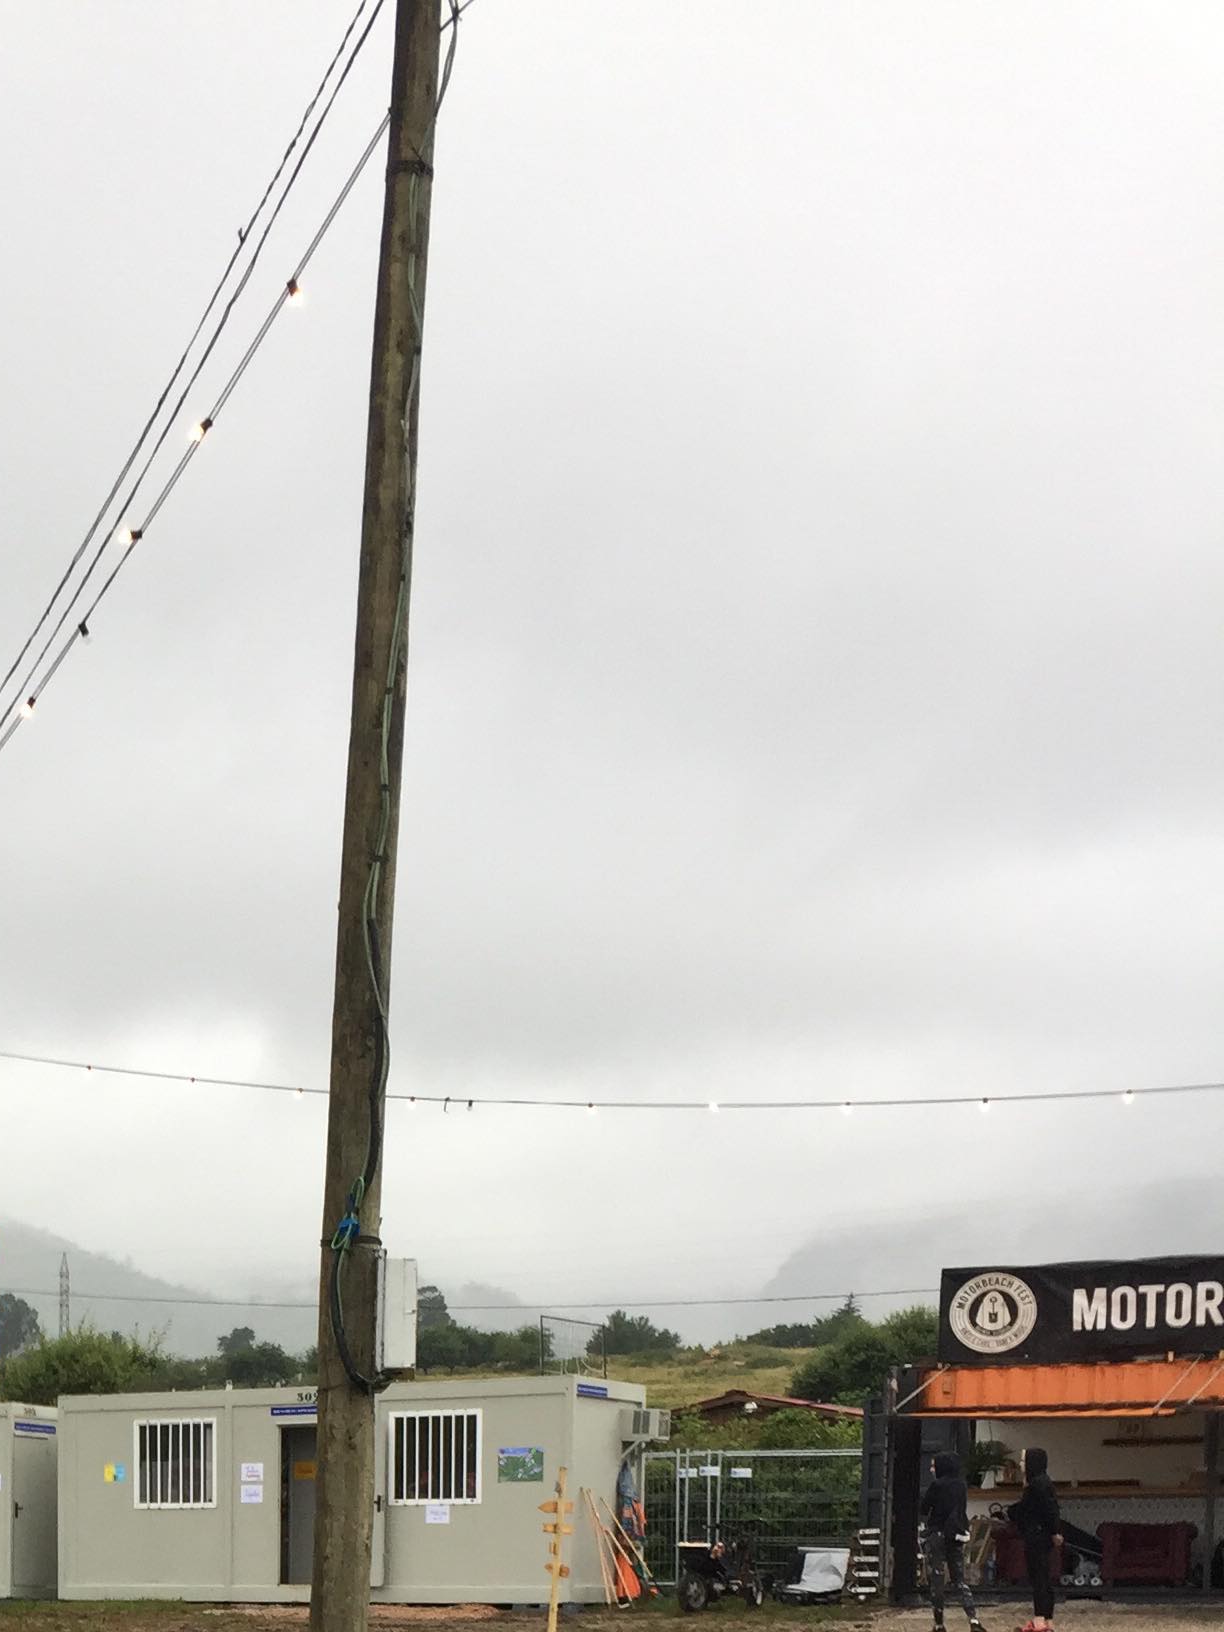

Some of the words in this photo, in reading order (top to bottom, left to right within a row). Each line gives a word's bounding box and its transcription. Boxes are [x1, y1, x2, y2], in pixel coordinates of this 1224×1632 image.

[956, 1277, 1014, 1310] MOTORBEACH
[1013, 1285, 1033, 1308] FEST
[1072, 1280, 1224, 1332] MOTOR
